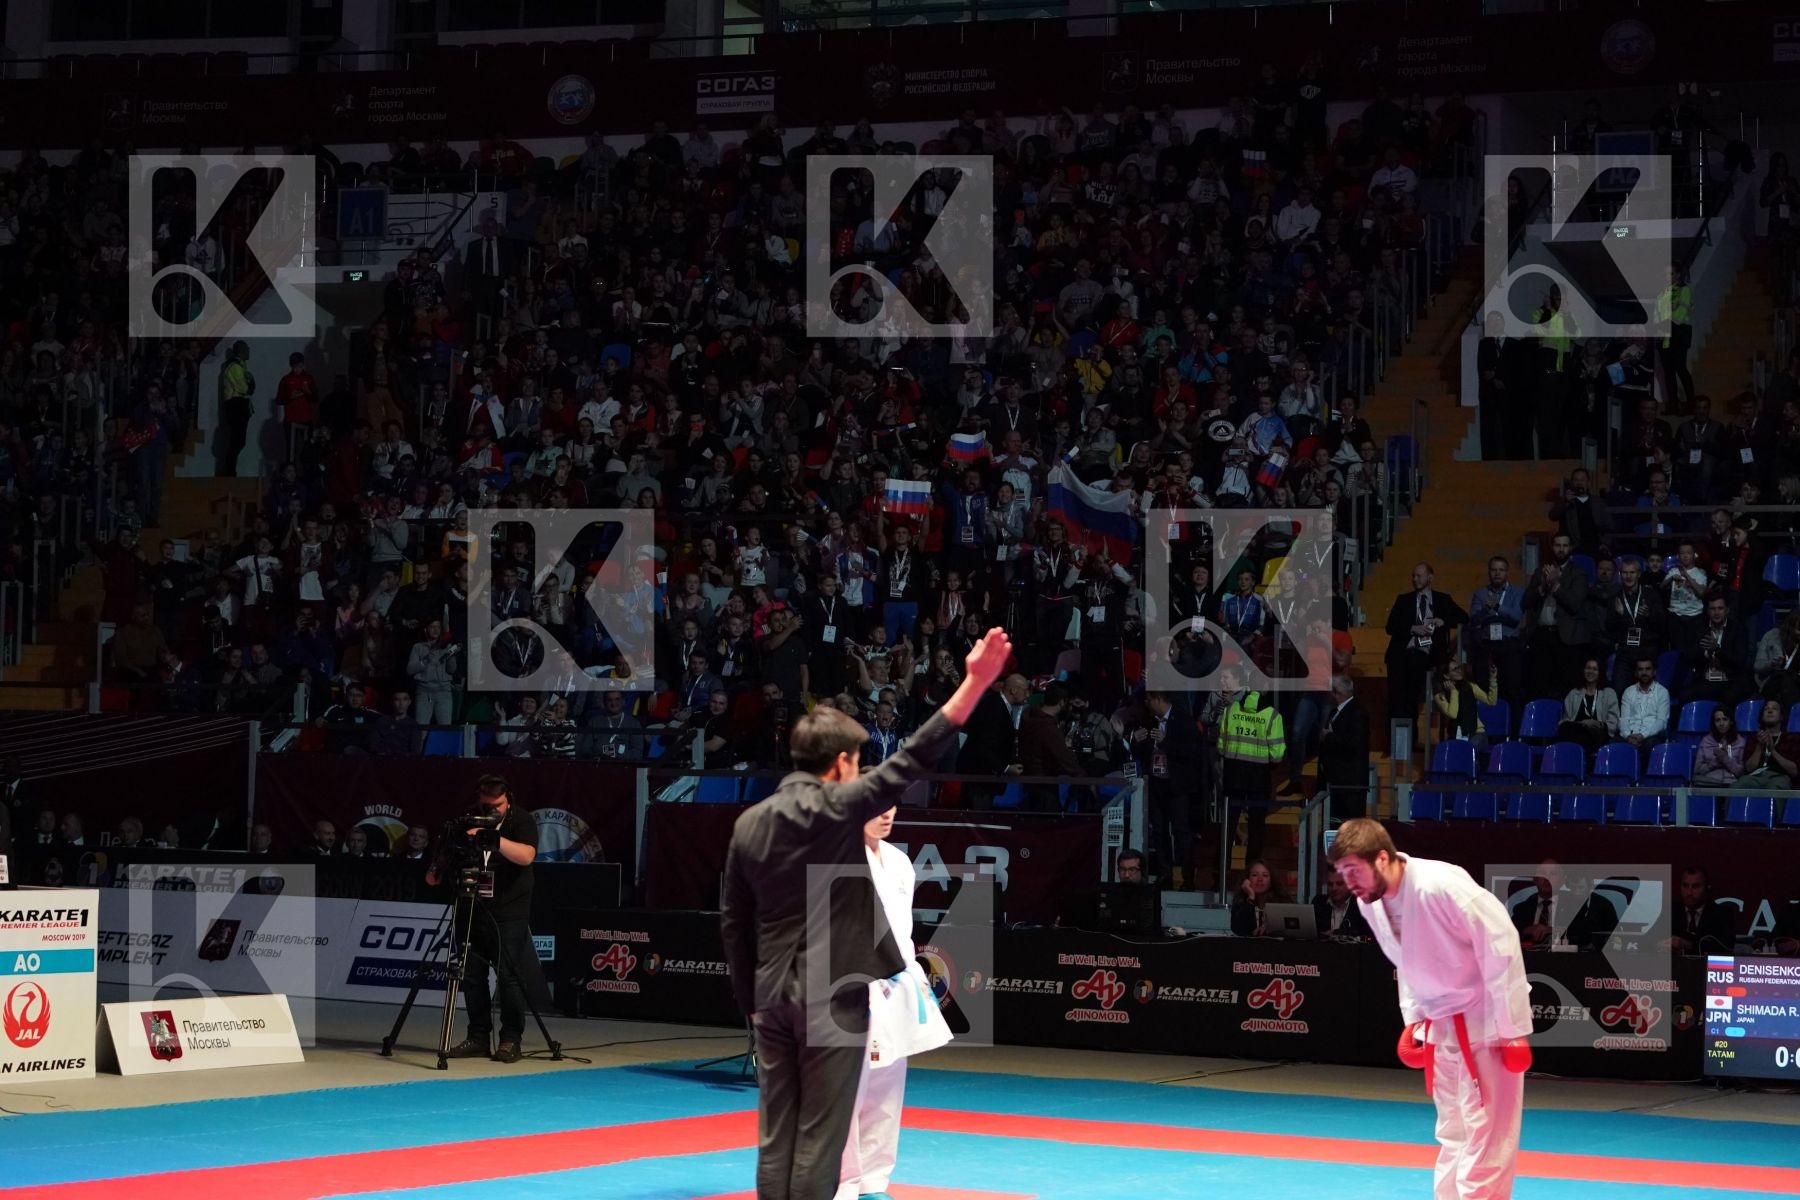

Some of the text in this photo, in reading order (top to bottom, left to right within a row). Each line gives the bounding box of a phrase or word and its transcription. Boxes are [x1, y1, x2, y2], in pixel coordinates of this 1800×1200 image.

[1146, 57, 1241, 71] Правительство
[697, 76, 775, 93] СОГАЗ
[1146, 73, 1194, 84] Москвы
[143, 99, 228, 111] Правительство
[142, 114, 185, 124] Москвы
[351, 207, 375, 235] A1
[1232, 714, 1265, 724] STEWARD
[1236, 727, 1257, 737] 1134
[364, 804, 403, 818] WORLD
[114, 880, 173, 890] PREMIER
[115, 864, 246, 893] KARATE1
[0, 909, 89, 926] KARATE1
[42, 934, 70, 942] MOSCOW
[243, 930, 329, 946] Правительство
[360, 925, 451, 950] СОГА
[581, 929, 594, 939] Eat
[98, 949, 167, 966] MPLEKT
[238, 944, 282, 958] Москвы
[13, 953, 41, 973] AO
[663, 959, 730, 975] KARATE1
[1058, 954, 1141, 968] Eat Well, Live Well.
[1233, 962, 1320, 976] Eat Well, Live Well.
[1739, 965, 1800, 977] DENISENKO
[1585, 977, 1680, 992] Eat Well, Live Well.
[1707, 972, 1734, 984] RUS
[586, 979, 640, 993] AJINOMOTO
[986, 977, 1063, 994] KARATE1
[1158, 986, 1239, 1003] KARATE1
[1065, 1009, 1130, 1024] AJINOMOTO
[1532, 1004, 1590, 1020] RATE1
[1706, 1012, 1731, 1023] JPN
[1737, 1005, 1800, 1017] SHIMADA R.
[183, 1017, 265, 1034] Правительство
[1240, 1018, 1309, 1034] AJINOMOTO
[15, 1028, 41, 1041] JAL
[188, 1037, 231, 1050] Москвы
[1594, 1036, 1667, 1051] AJINOMOTO
[1715, 1040, 1728, 1048] #20
[1707, 1050, 1735, 1058] TATAMI
[16, 1058, 86, 1072] AIRLINES
